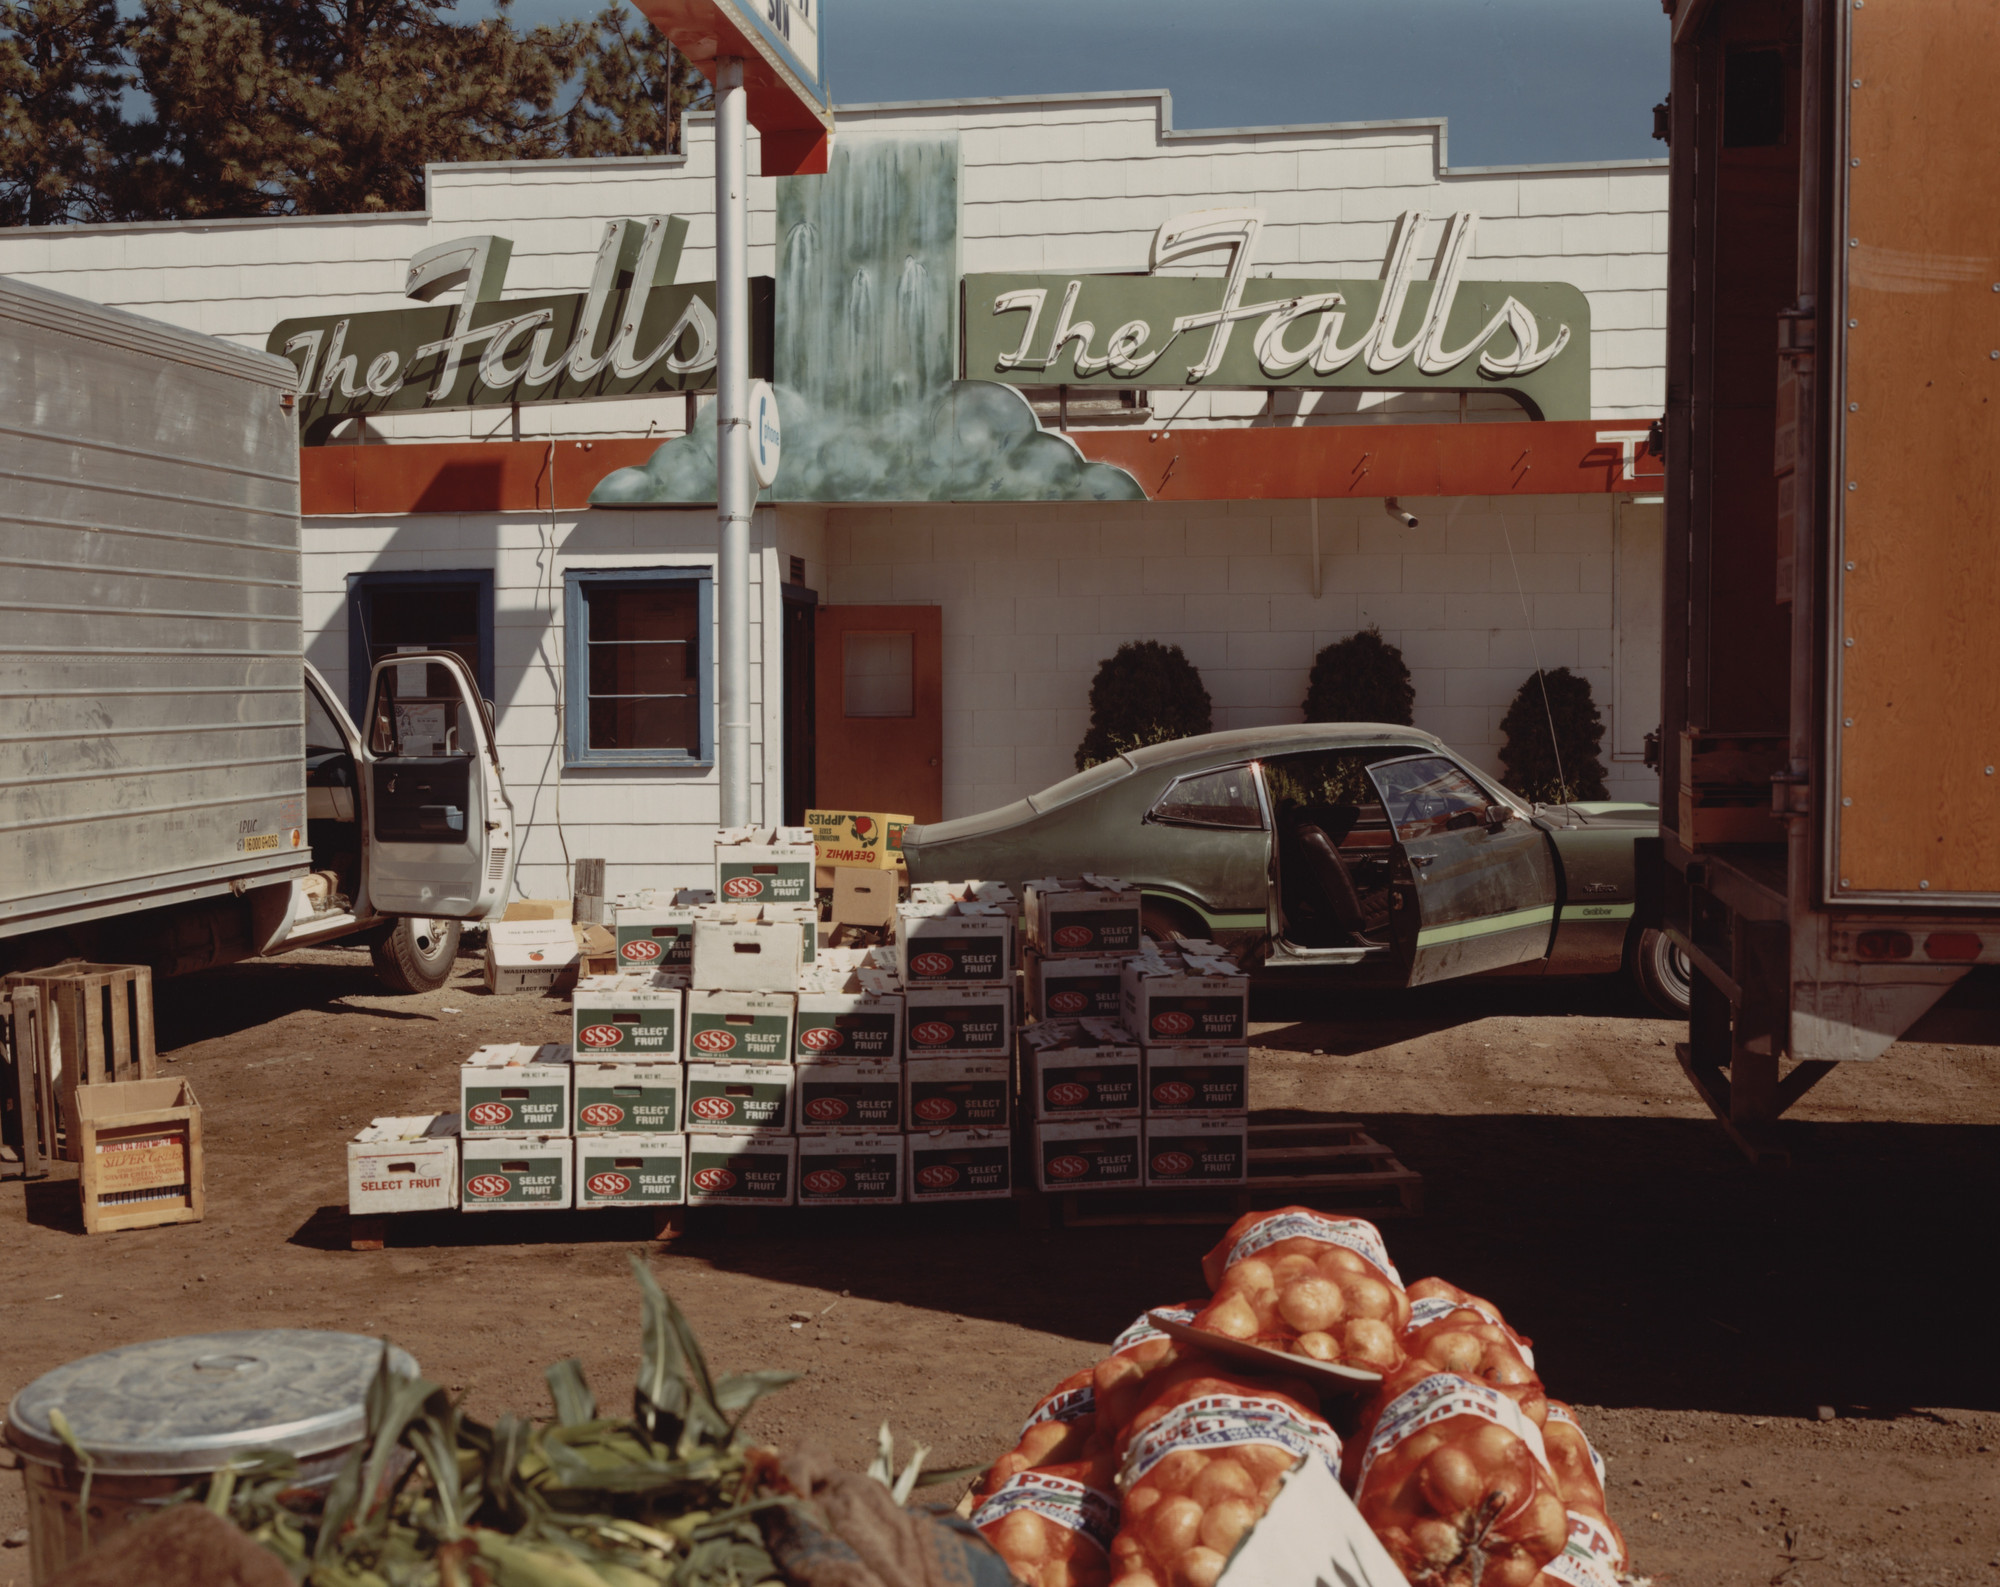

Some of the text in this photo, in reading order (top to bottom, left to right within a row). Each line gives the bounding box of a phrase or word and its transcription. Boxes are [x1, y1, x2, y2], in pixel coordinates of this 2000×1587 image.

[993, 207, 1571, 379] The Falls
[764, 420, 779, 447] phone
[729, 879, 757, 895] SSS
[771, 879, 805, 887] SELECT
[774, 888, 801, 896] FRUIT
[1100, 927, 1134, 935] SELECT
[1103, 936, 1130, 944] FRUIT
[627, 942, 655, 958] SSS
[668, 941, 692, 950] SELE
[672, 950, 692, 959] FRU
[961, 955, 998, 964] SELECT
[965, 965, 993, 973] FRUIT
[1202, 1015, 1238, 1023] SELECT
[632, 1027, 669, 1036] SELECT
[962, 1023, 999, 1033] SELECT
[1205, 1024, 1233, 1032] FRUIT
[586, 1027, 616, 1044] SSS
[745, 1034, 781, 1043] SELECT
[852, 1031, 889, 1041] SELECT
[965, 1033, 994, 1042] FRUIT
[635, 1037, 664, 1046] FRUIT
[700, 1032, 730, 1049] SSS
[748, 1044, 777, 1053] FRUIT
[855, 1041, 884, 1050] FRUIT
[1097, 1083, 1133, 1093] SELECT
[1203, 1084, 1238, 1092] SELECT
[1101, 1093, 1129, 1102] FRUIT
[1206, 1094, 1234, 1102] FRUIT
[698, 1099, 729, 1116] SSS
[743, 1101, 780, 1111] SELECT
[857, 1101, 893, 1109] SELECT
[965, 1100, 1001, 1108] SELECT
[475, 1104, 506, 1122] SSS
[521, 1104, 559, 1114] SELECT
[633, 1106, 670, 1115] SELECT
[968, 1109, 997, 1118] FRUIT
[524, 1114, 554, 1124] FRUIT
[587, 1106, 618, 1123] SSS
[746, 1111, 775, 1120] FRUIT
[860, 1110, 889, 1119] FRUIT
[636, 1116, 666, 1125] FRUIT
[104, 1149, 184, 1168] SILVER CREE
[1097, 1155, 1133, 1165] SELECT
[1201, 1154, 1237, 1163] SELECT
[968, 1165, 1003, 1175] SELECT
[1101, 1164, 1129, 1174] FRUIT
[1205, 1164, 1232, 1172] FRUIT
[519, 1176, 557, 1186] SELECT
[640, 1175, 676, 1184] SELECT
[745, 1172, 782, 1182] SELECT
[855, 1173, 891, 1181] SELECT
[971, 1175, 999, 1184] FRUIT
[361, 1178, 441, 1192] SELECT FRUIT
[474, 1176, 505, 1194] SSS
[594, 1175, 625, 1192] SSS
[748, 1182, 777, 1191] FRUIT
[858, 1182, 887, 1191] FRUIT
[523, 1186, 552, 1195] FRUIT
[642, 1185, 672, 1194] FRUIT
